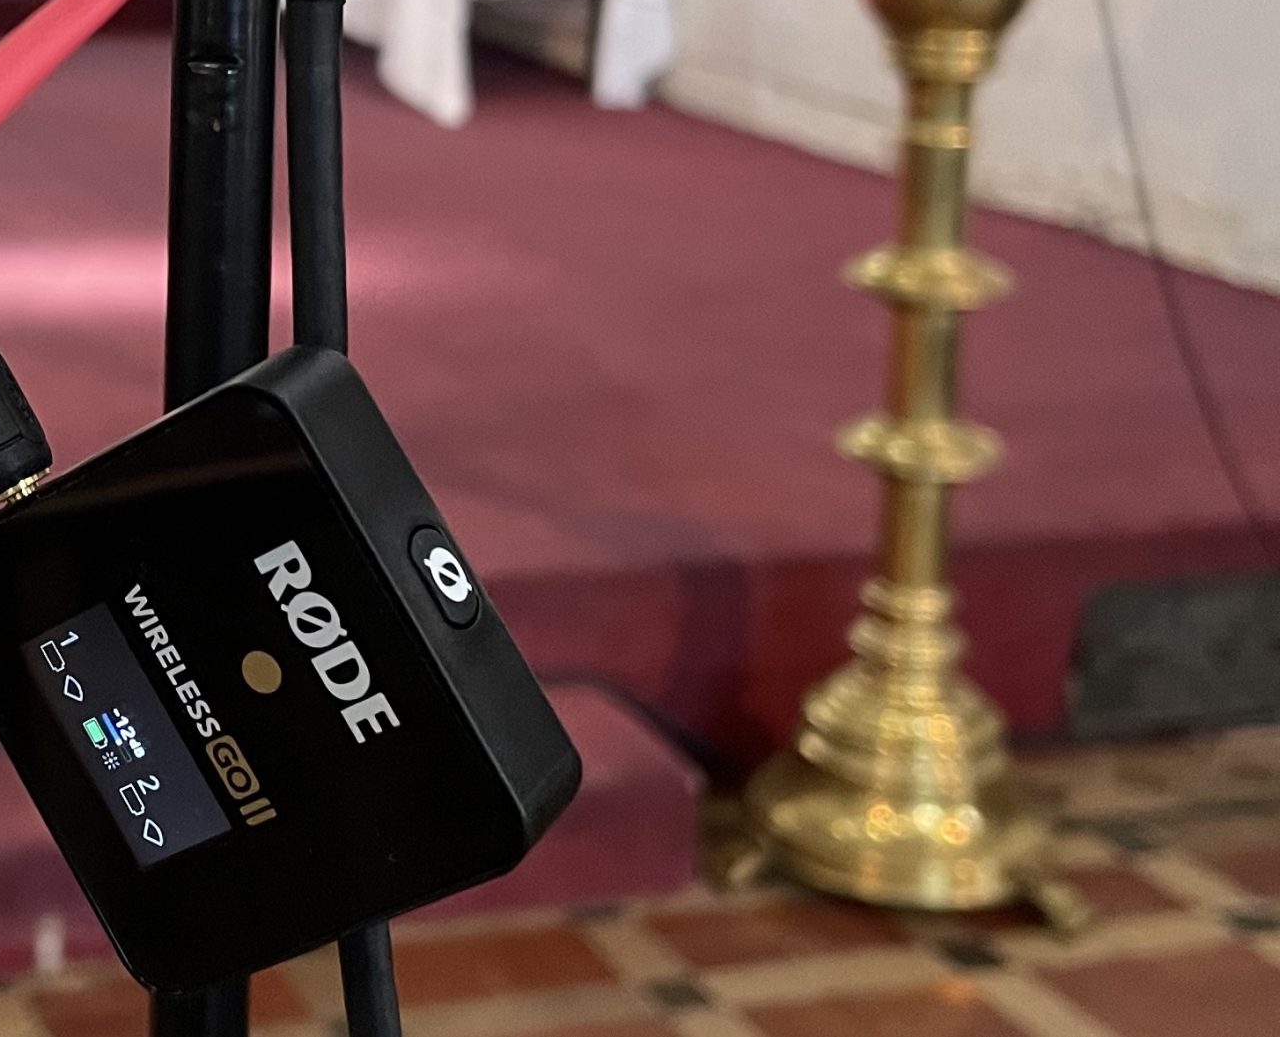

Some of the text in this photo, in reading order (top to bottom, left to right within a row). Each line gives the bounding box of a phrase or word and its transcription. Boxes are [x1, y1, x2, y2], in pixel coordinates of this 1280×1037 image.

[60, 631, 80, 647] 1
[124, 583, 221, 738] WIRELESS
[210, 740, 254, 795] GO
[254, 540, 400, 744] RØDE
[137, 775, 161, 795] 2
